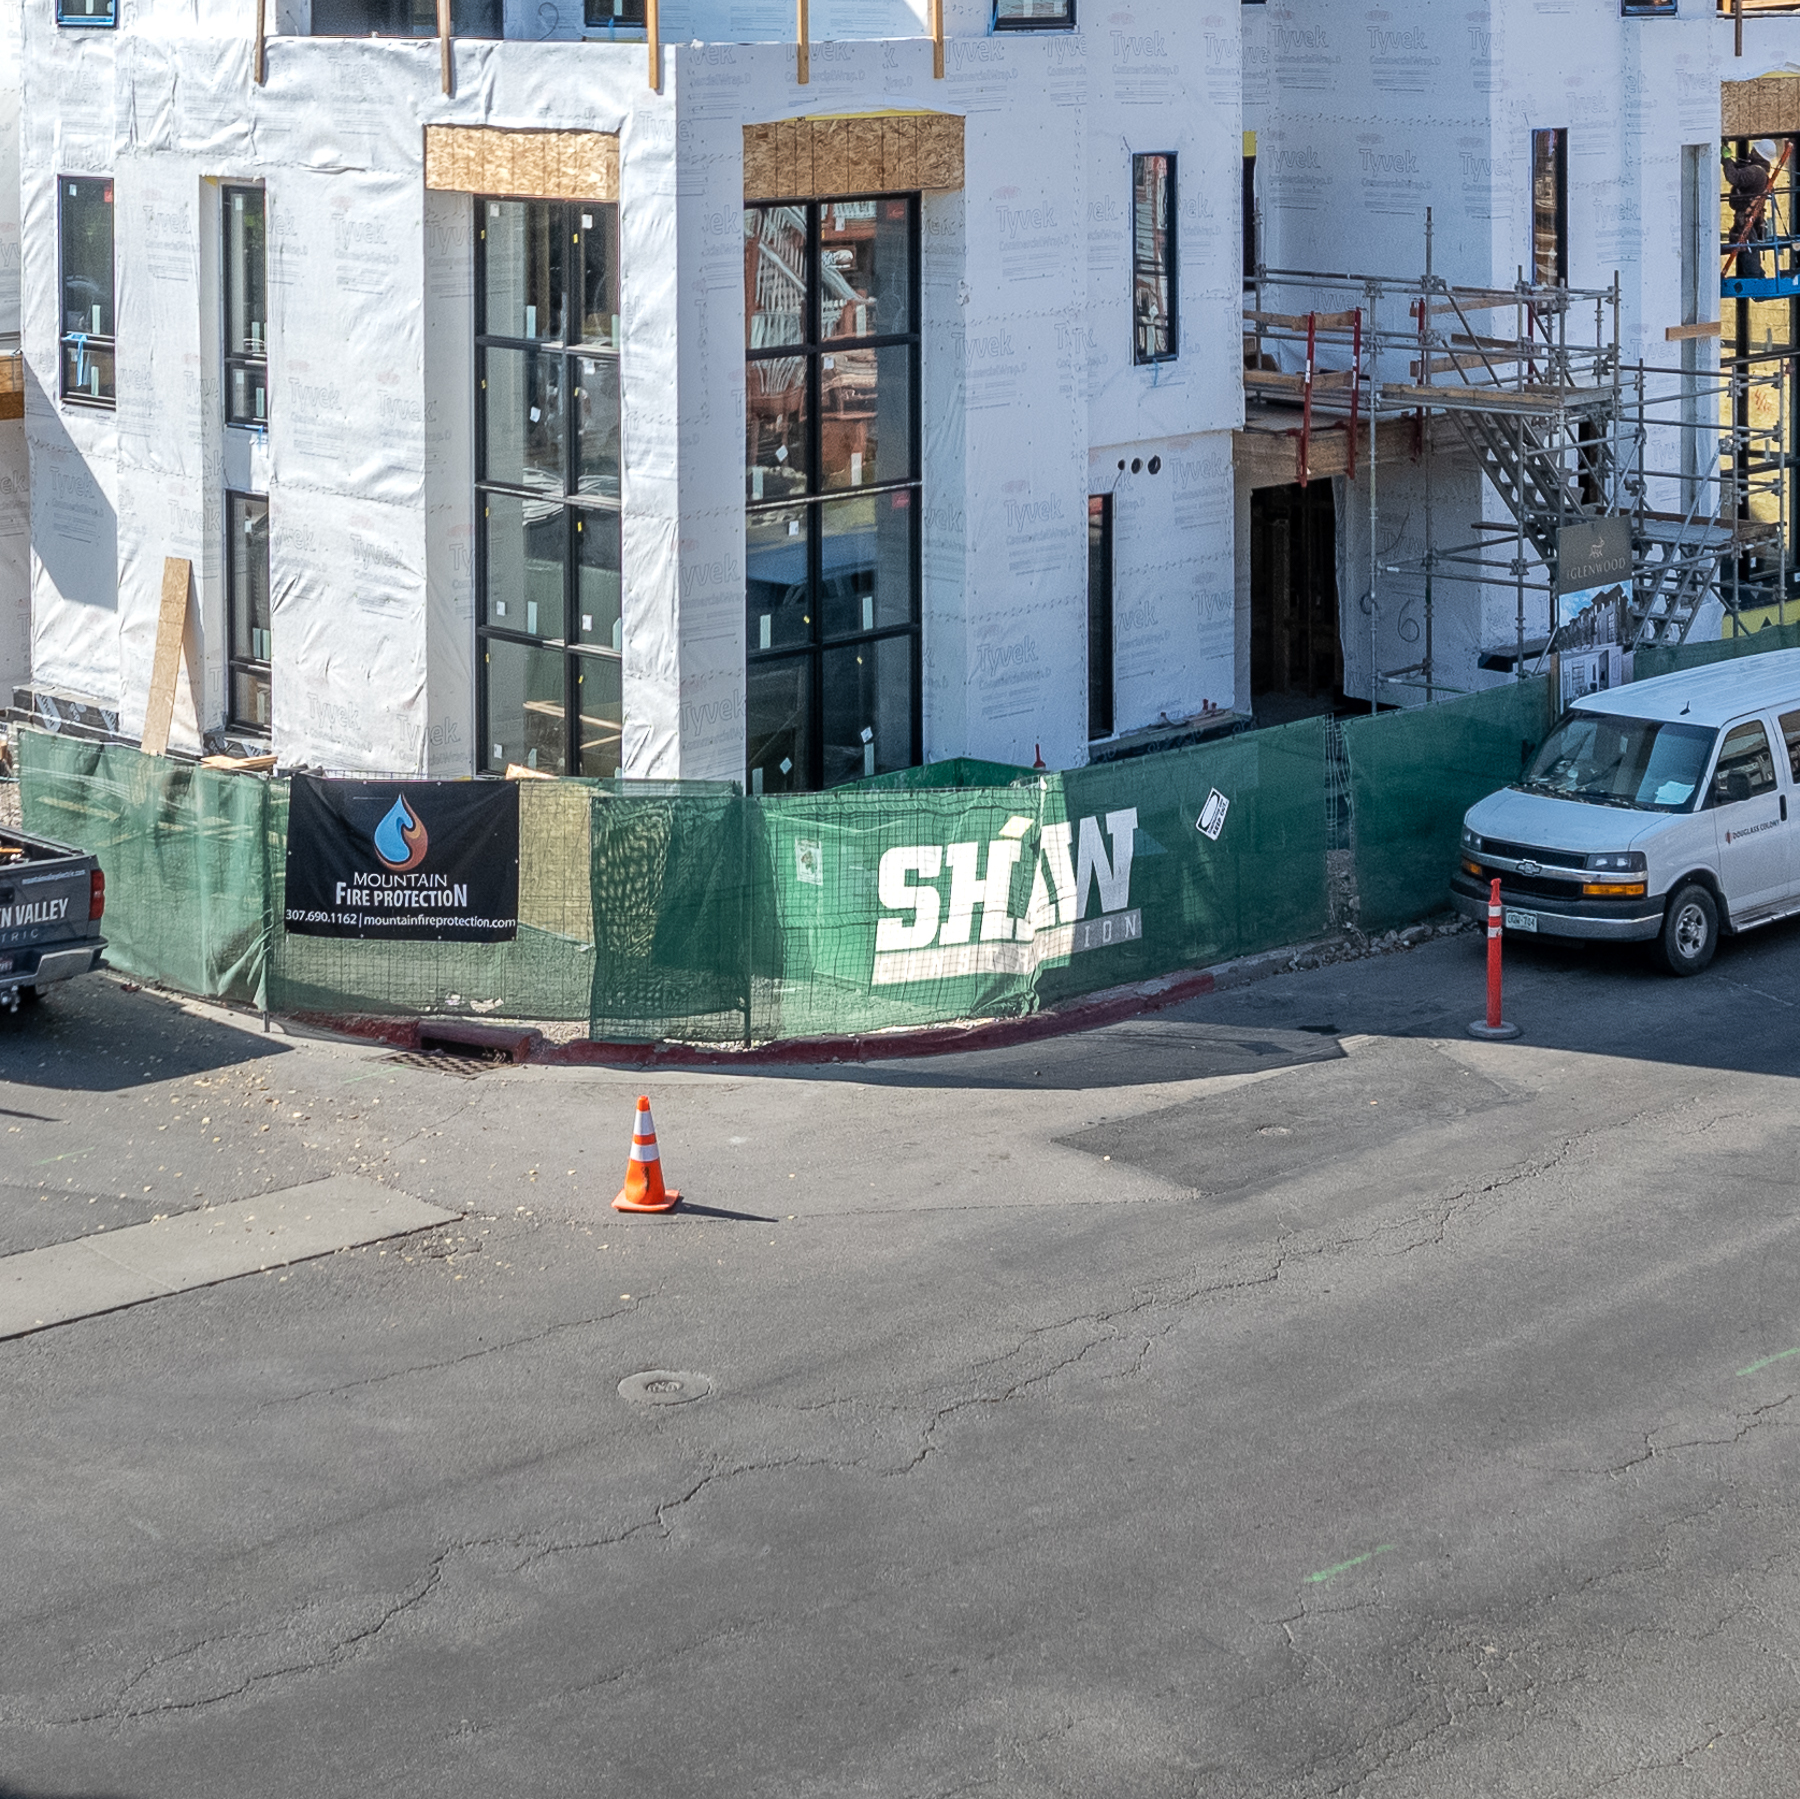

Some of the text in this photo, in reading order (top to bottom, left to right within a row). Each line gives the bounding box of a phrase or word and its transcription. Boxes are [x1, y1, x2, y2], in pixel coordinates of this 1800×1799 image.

[944, 36, 1004, 65] Tyvek
[1110, 30, 1166, 60] Tyvek
[1272, 26, 1329, 51] Tyvek
[1367, 26, 1426, 52] Tyvek
[1266, 145, 1321, 173] Tyvek
[1358, 147, 1419, 174] Tyvek
[331, 212, 387, 244] Tyvek
[996, 205, 1057, 234] Tyvek
[1004, 497, 1064, 525] Tyvek
[1570, 557, 1626, 579] GLENWOOD
[976, 641, 1037, 673] Tyvek
[1732, 820, 1780, 839] DOUGLASS COLONY
[353, 872, 447, 888] MOUNTAIN
[875, 806, 1138, 952] SHAW
[336, 882, 468, 907] FIRE PROTECTION
[15, 898, 69, 926] VALLEY
[285, 909, 515, 928] 307.690.1162 mountainfireprotection.com
